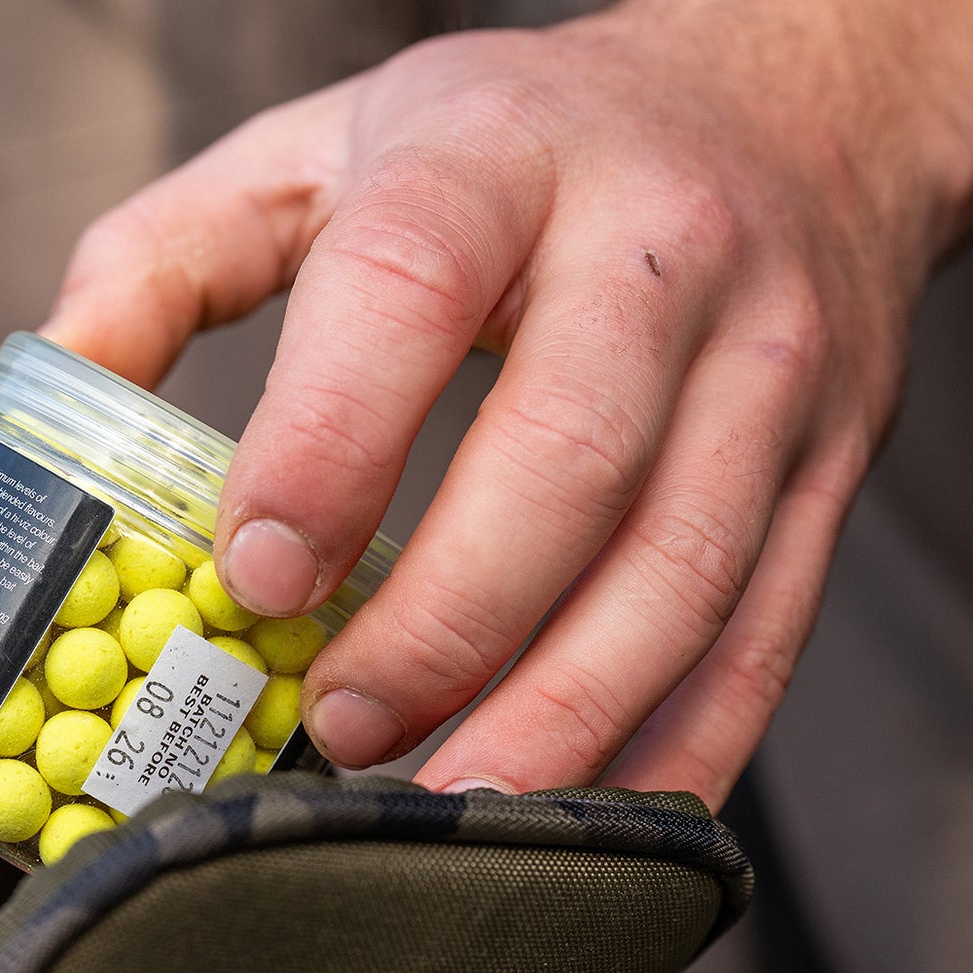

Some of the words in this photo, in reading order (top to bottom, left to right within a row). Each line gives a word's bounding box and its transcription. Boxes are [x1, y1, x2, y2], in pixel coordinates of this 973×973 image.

[13, 479, 37, 499] levels
[34, 491, 48, 505] of
[3, 510, 11, 519] a
[9, 511, 32, 531] hi-viz
[6, 527, 27, 545] level
[23, 537, 37, 551] of
[13, 549, 29, 564] the
[7, 564, 35, 587] easily
[136, 680, 174, 719] 08
[178, 674, 210, 719] BEST
[175, 693, 213, 751] BATCH
[106, 730, 146, 770] 26
[137, 720, 182, 787] BEFORE
[161, 693, 241, 797] 1121212
[158, 752, 179, 779] NO
